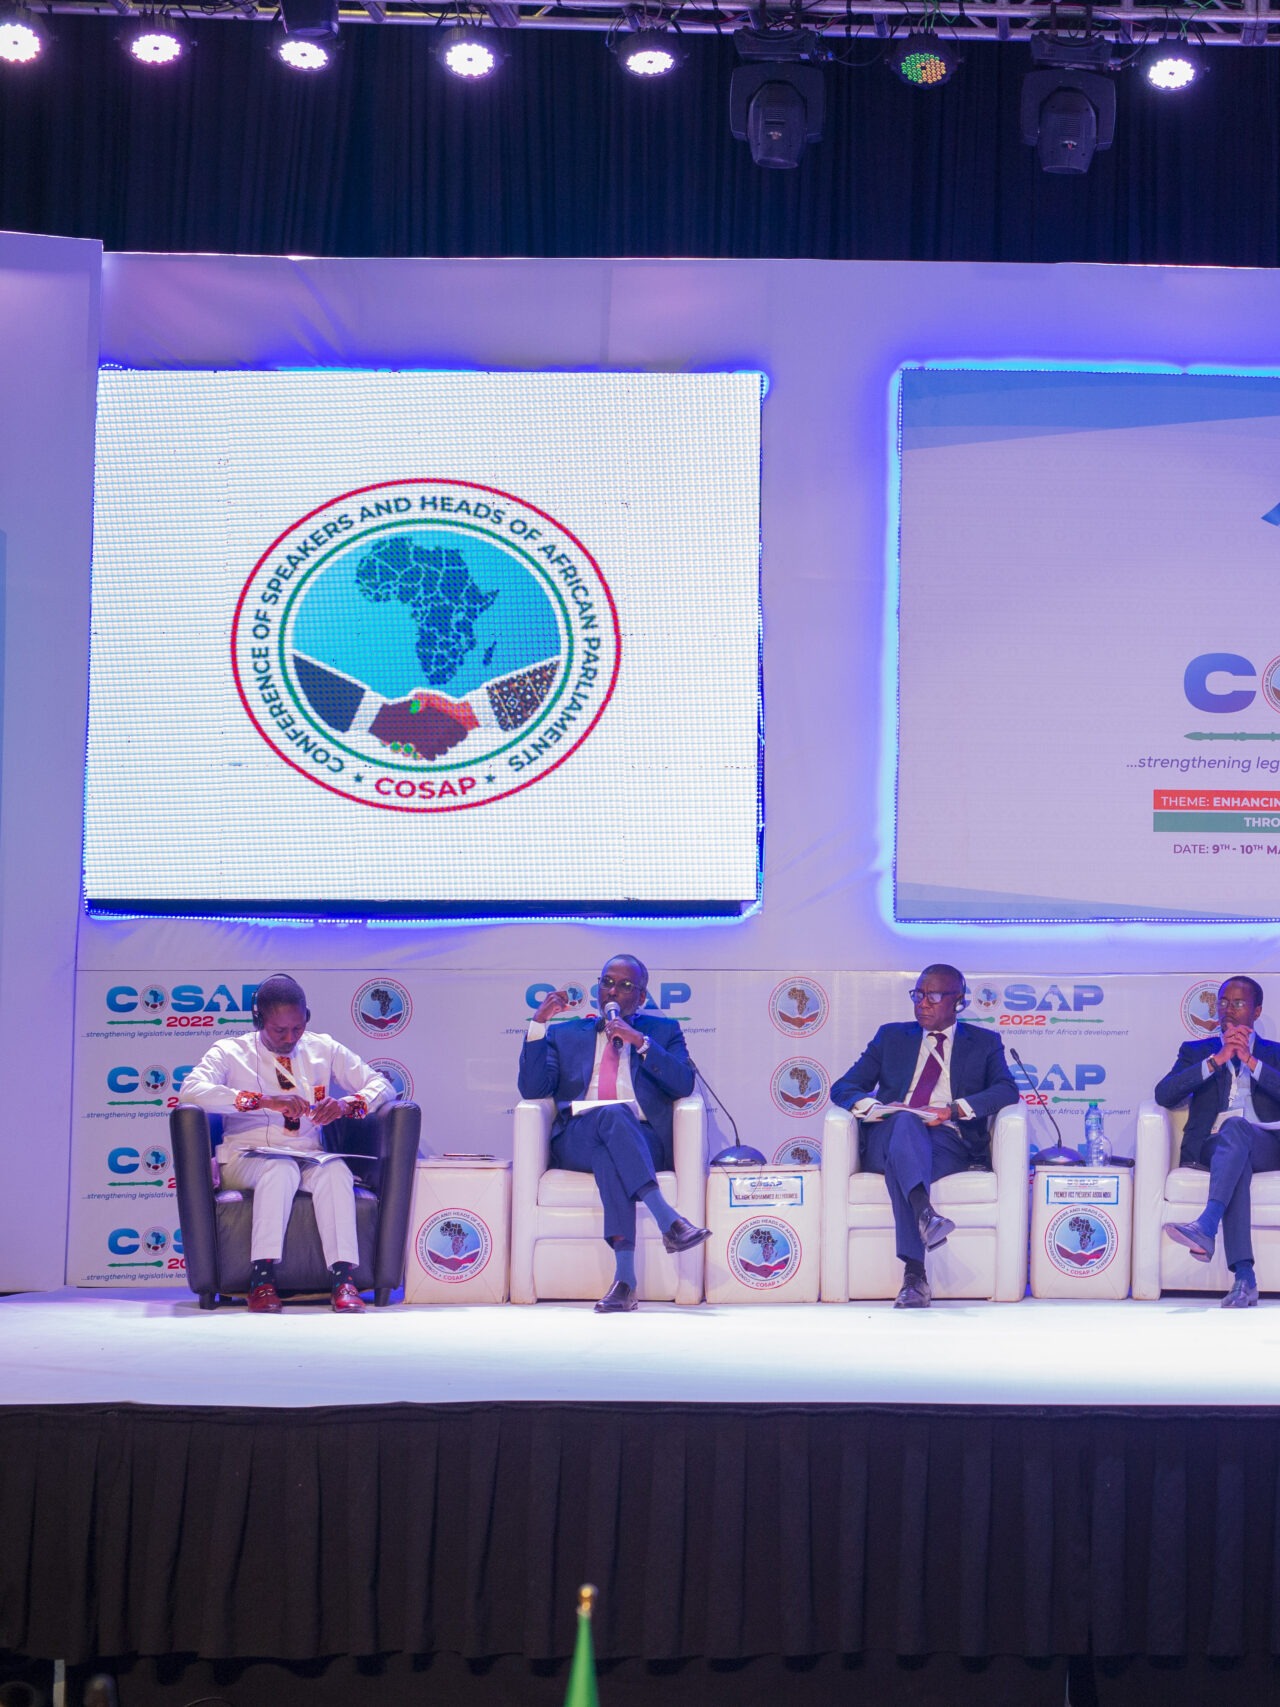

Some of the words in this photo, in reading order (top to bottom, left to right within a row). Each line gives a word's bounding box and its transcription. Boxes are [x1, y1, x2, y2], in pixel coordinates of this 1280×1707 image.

[359, 496, 412, 522] AND
[421, 496, 506, 525] HEADS
[509, 519, 542, 541] OF
[261, 514, 354, 605] SPEAKERS
[537, 544, 598, 630] AFRICAN
[252, 609, 271, 640] OF
[251, 646, 345, 773] CONFERENCE
[508, 637, 601, 772] PARLIAMENTS
[1126, 756, 1251, 771] ...strengthening
[375, 776, 476, 799] COSAP
[1161, 796, 1210, 807] THEME:
[1173, 844, 1209, 854] DATE:
[1240, 845, 1263, 855] 10TH
[166, 1016, 214, 1027] 2022
[999, 1014, 1046, 1026] 2022
[137, 1030, 172, 1038] legislative
[174, 1029, 211, 1038] leadership
[1006, 1029, 1043, 1037] leadership
[1083, 1029, 1129, 1037] development
[138, 1191, 174, 1200] legislative
[138, 1271, 173, 1280] legislative
